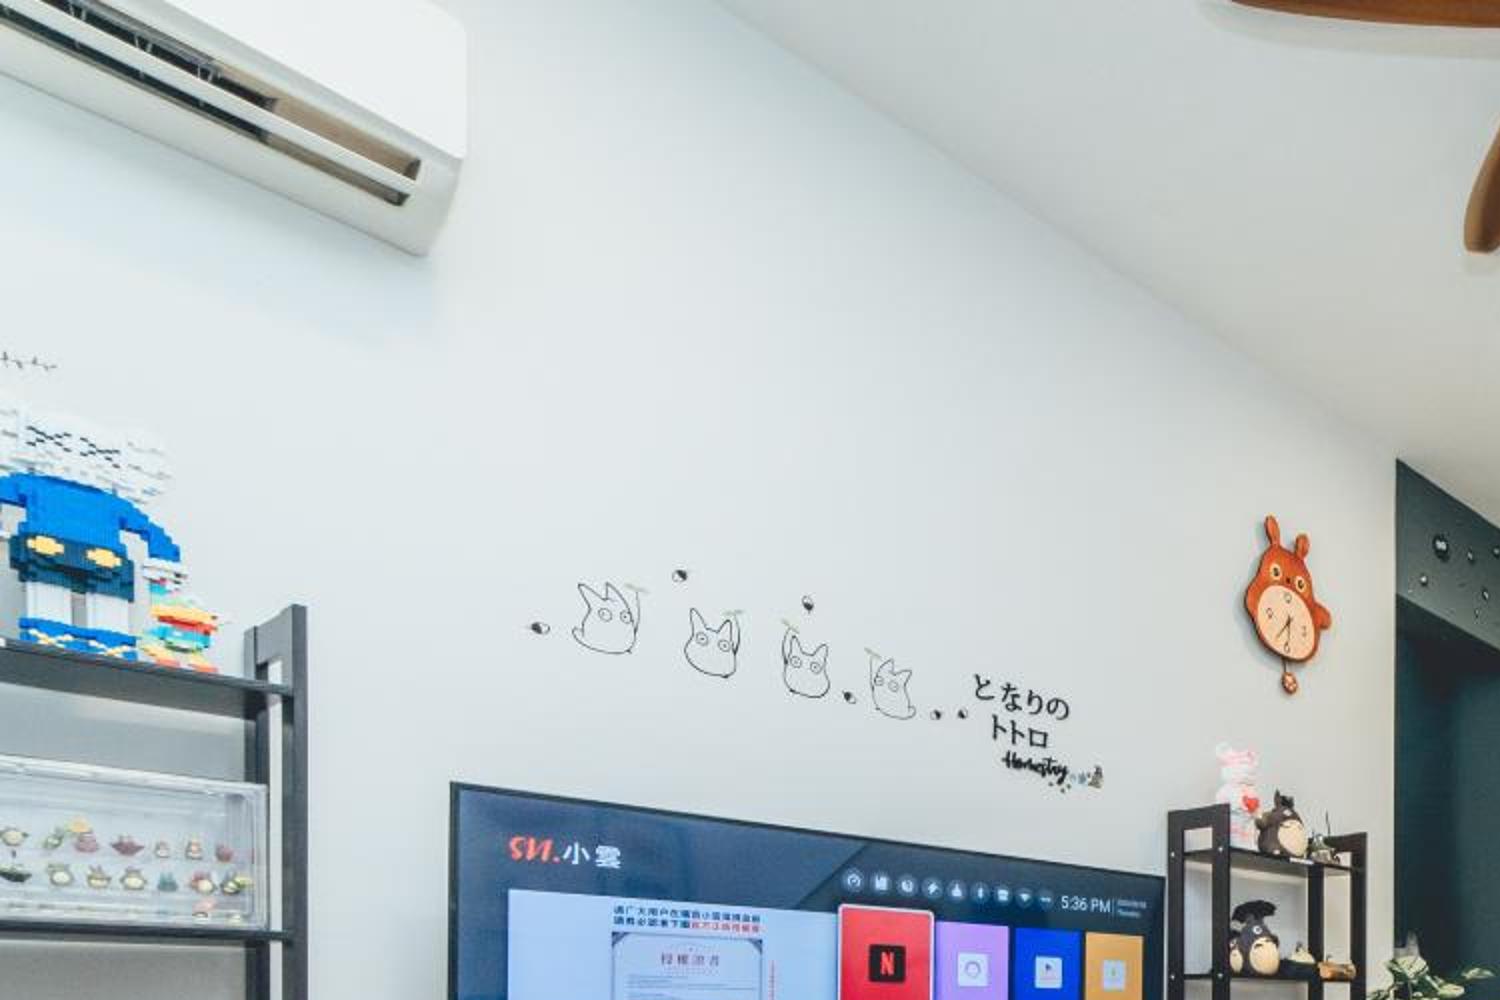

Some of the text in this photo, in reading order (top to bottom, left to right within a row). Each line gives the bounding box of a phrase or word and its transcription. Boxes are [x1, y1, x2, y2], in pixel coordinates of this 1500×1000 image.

[974, 673, 1070, 721] となりの
[992, 713, 1049, 749] トトロ
[1090, 896, 1112, 913] PM
